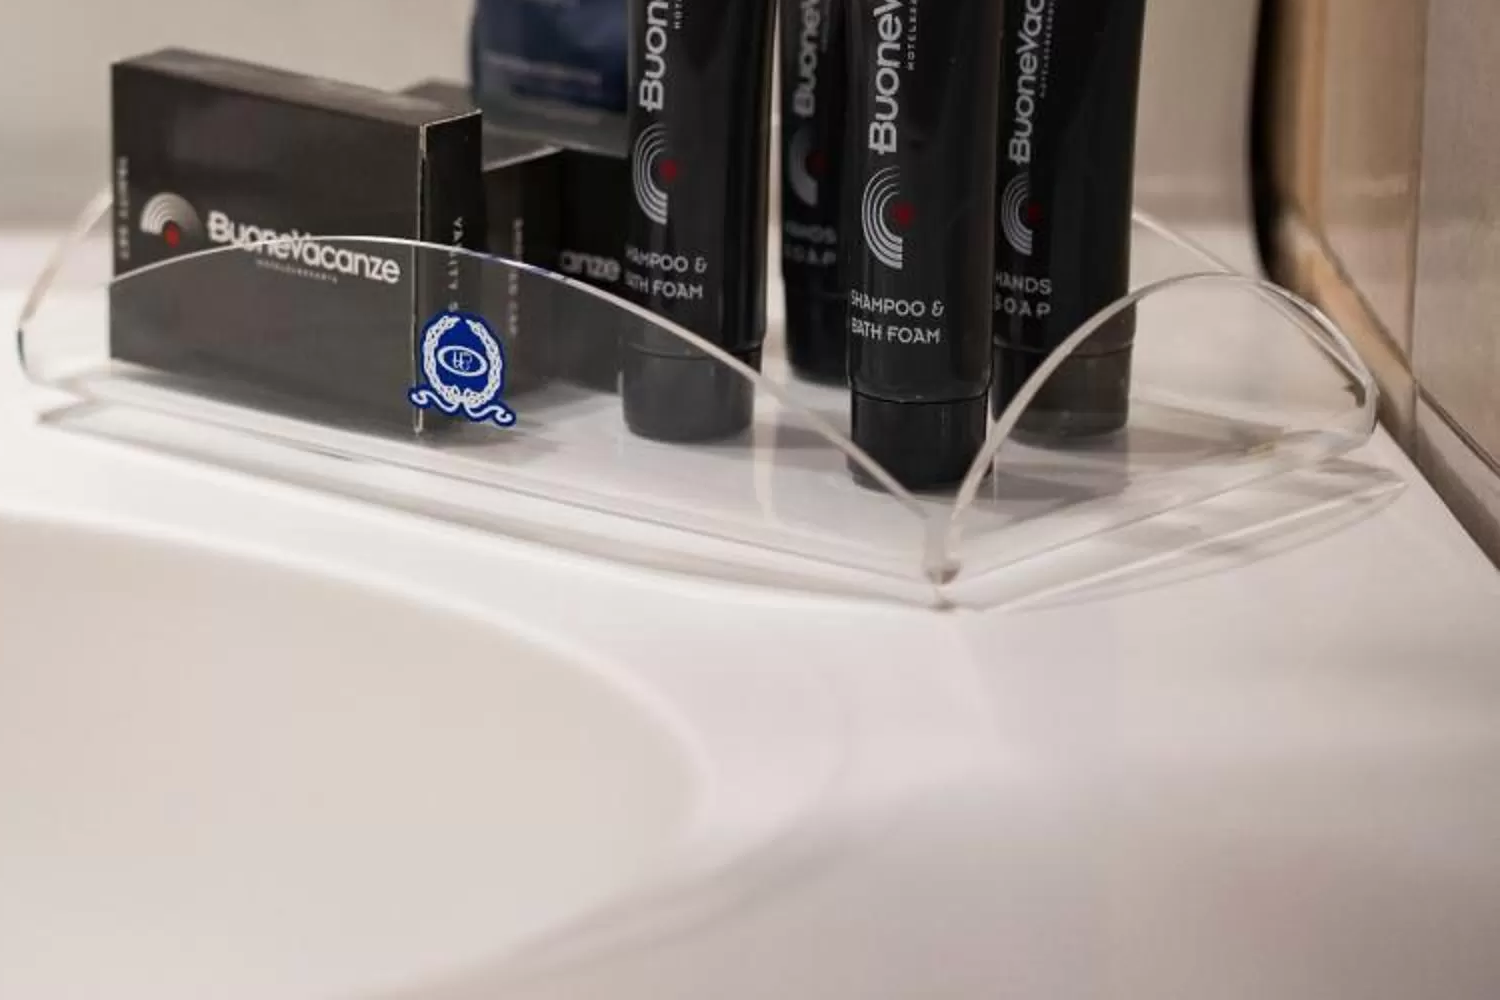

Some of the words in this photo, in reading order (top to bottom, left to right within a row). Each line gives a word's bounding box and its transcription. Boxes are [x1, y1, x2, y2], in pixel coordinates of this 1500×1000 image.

[207, 210, 400, 284] BuoneVacanze
[694, 256, 708, 273] &
[653, 279, 704, 300] FOAM
[995, 273, 1053, 296] HANDS
[851, 288, 925, 317] SHAMPOO
[931, 300, 944, 317] &
[851, 316, 882, 341] BATH
[886, 326, 941, 344] FOAM
